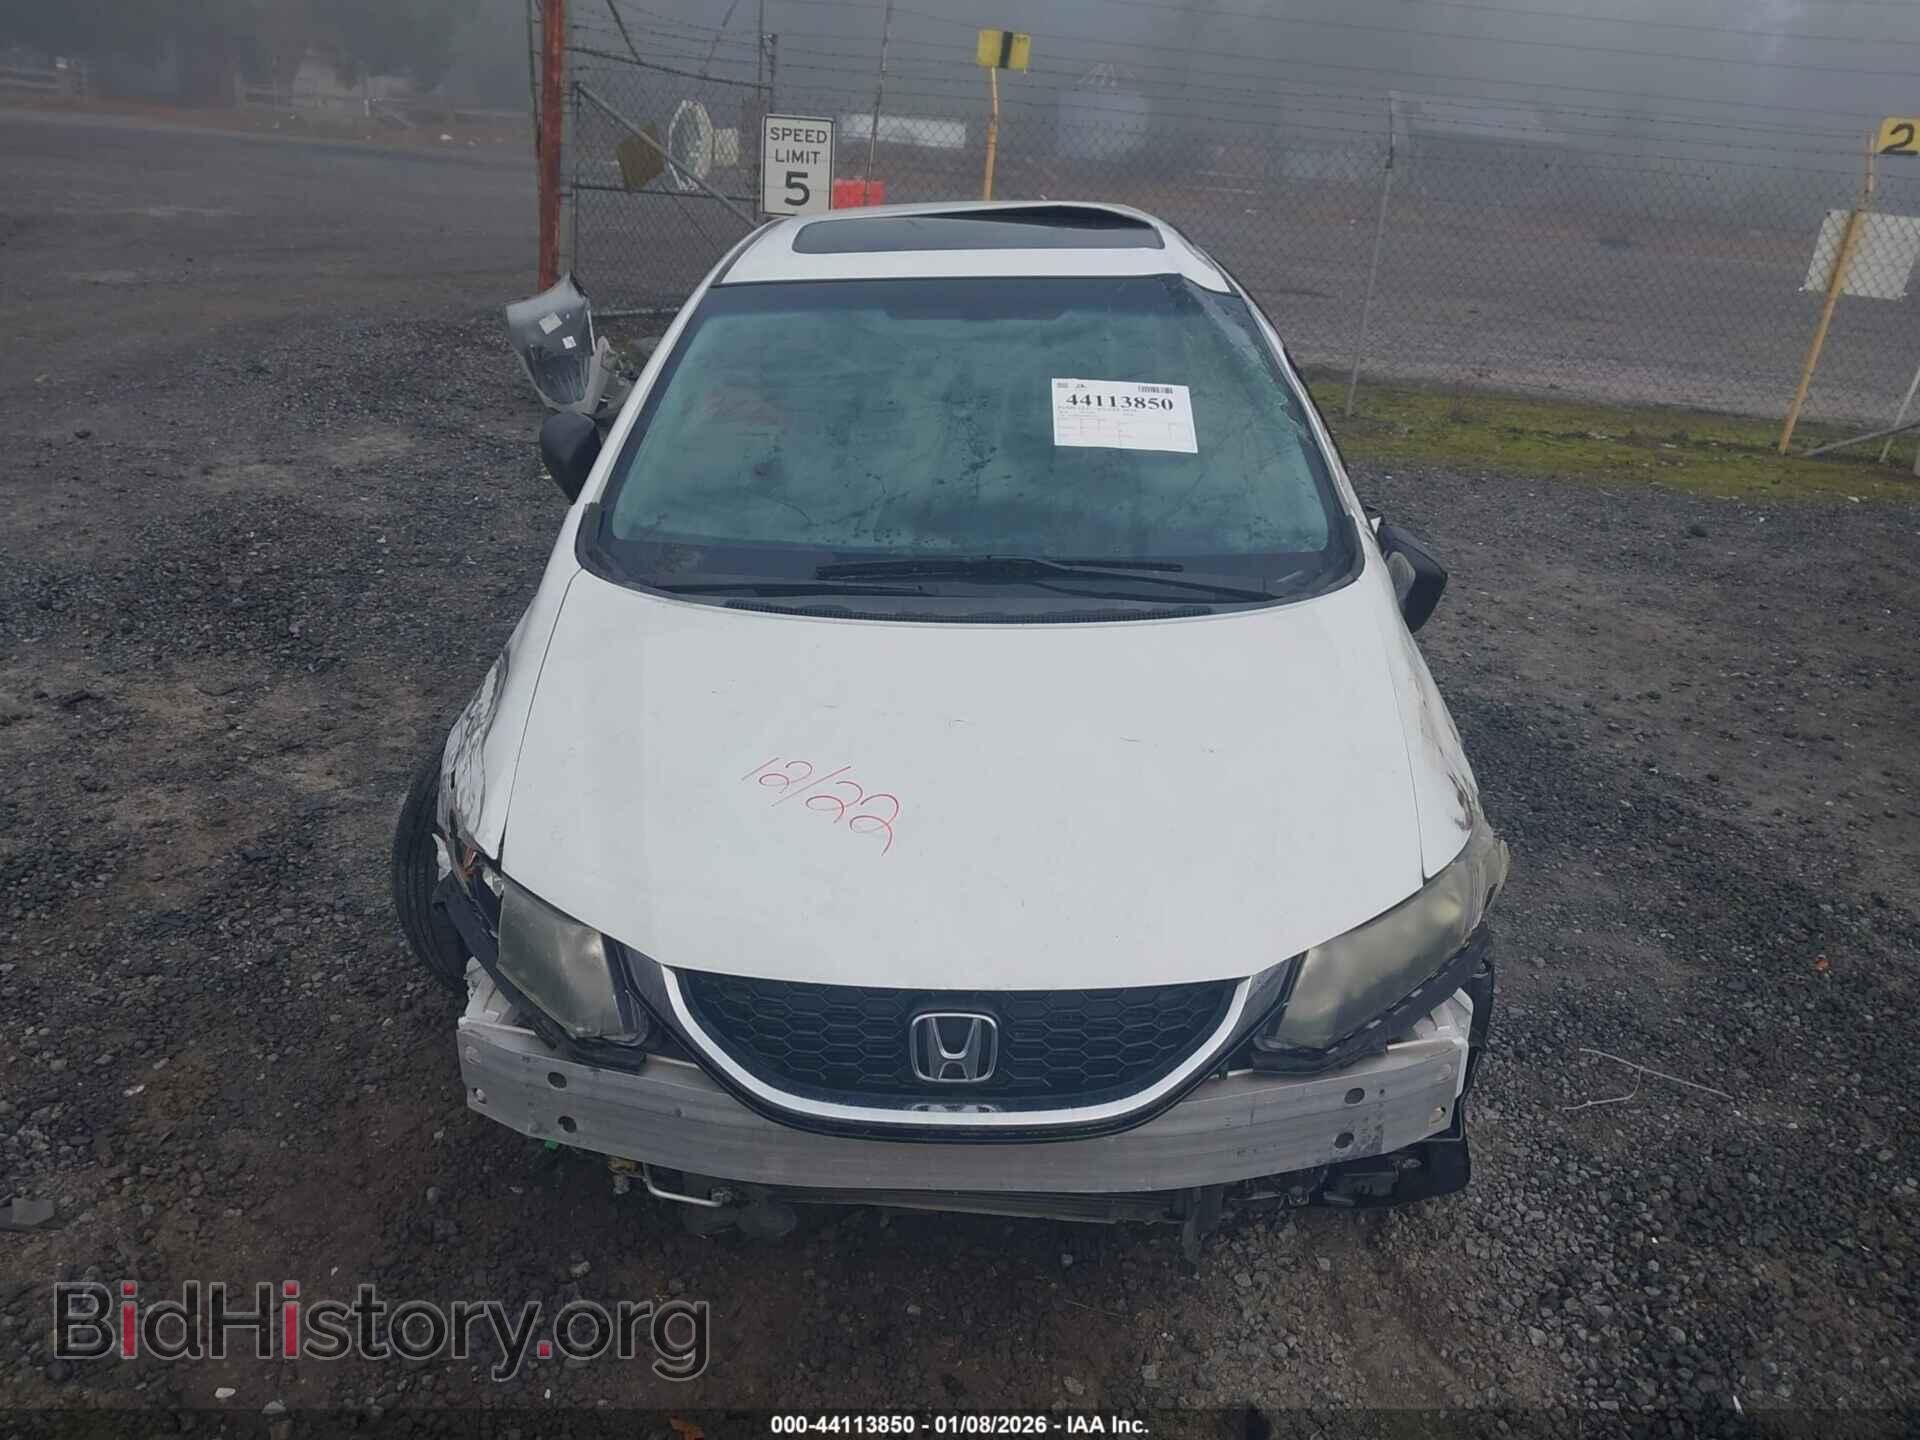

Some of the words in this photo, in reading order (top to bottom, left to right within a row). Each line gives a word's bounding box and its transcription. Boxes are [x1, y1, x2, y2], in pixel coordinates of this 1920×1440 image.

[770, 127, 828, 144] SPEED
[1879, 122, 1919, 156] 2
[775, 148, 821, 164] LIMIT
[784, 171, 810, 206] 5
[1066, 393, 1174, 411] 44113850
[741, 757, 899, 856] 12/22
